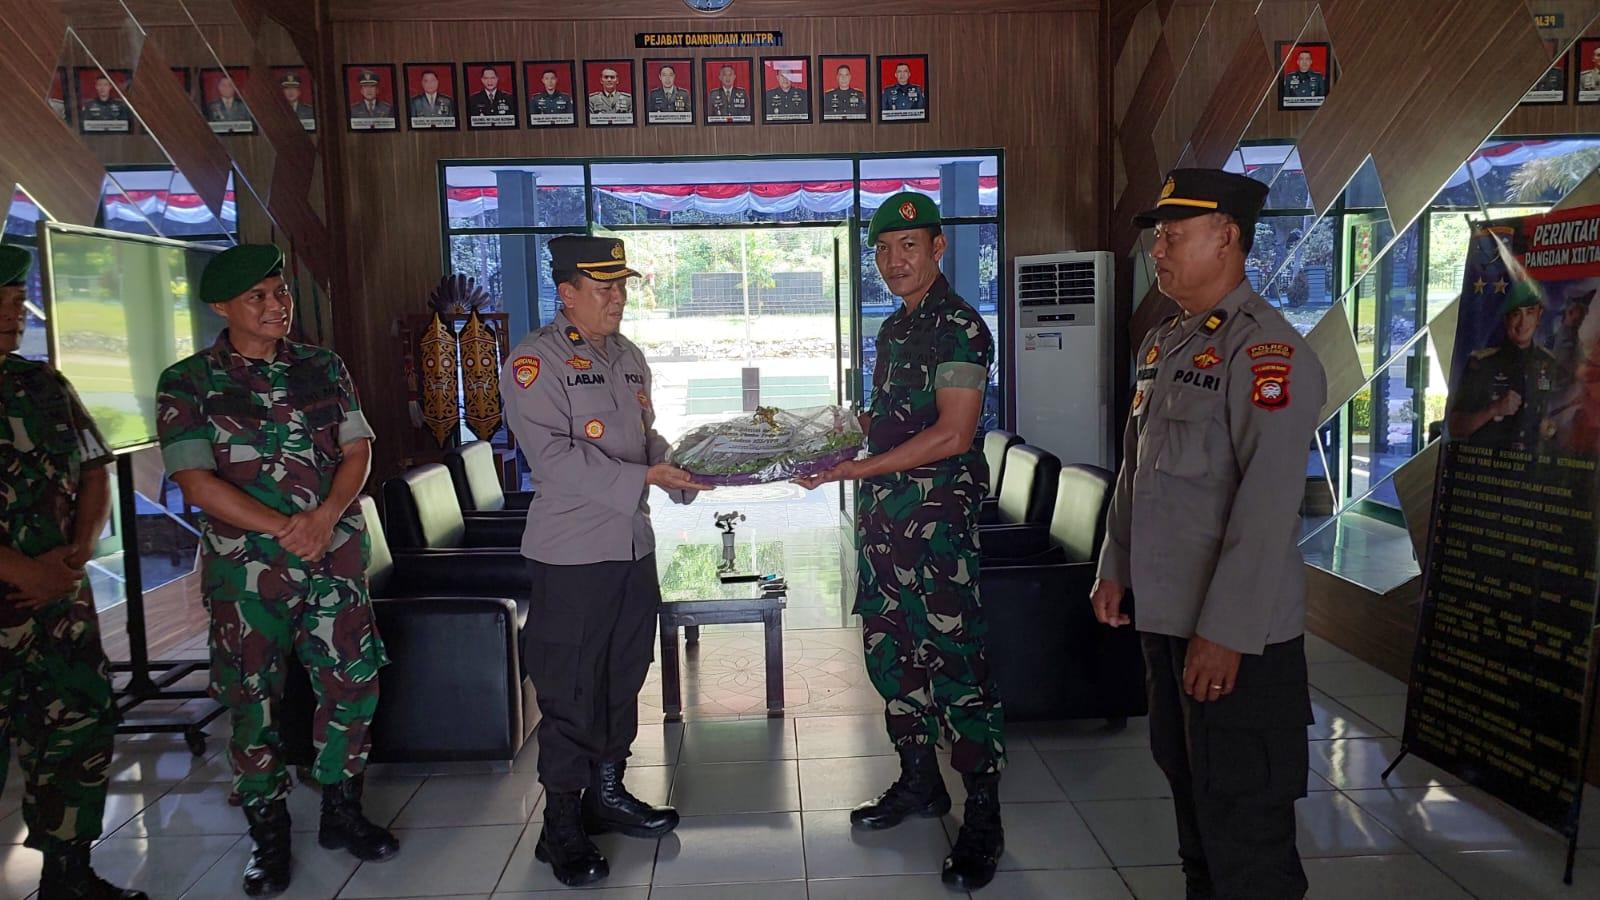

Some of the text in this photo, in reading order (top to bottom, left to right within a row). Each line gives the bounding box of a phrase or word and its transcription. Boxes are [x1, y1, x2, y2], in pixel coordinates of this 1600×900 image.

[644, 32, 774, 46] PEJABAT DANRINDAM XII/TPR
[1533, 217, 1600, 247] PERINTAH
[1524, 248, 1570, 268] PANGDAM
[566, 373, 605, 387] LABAN
[1173, 369, 1221, 391] POLRI
